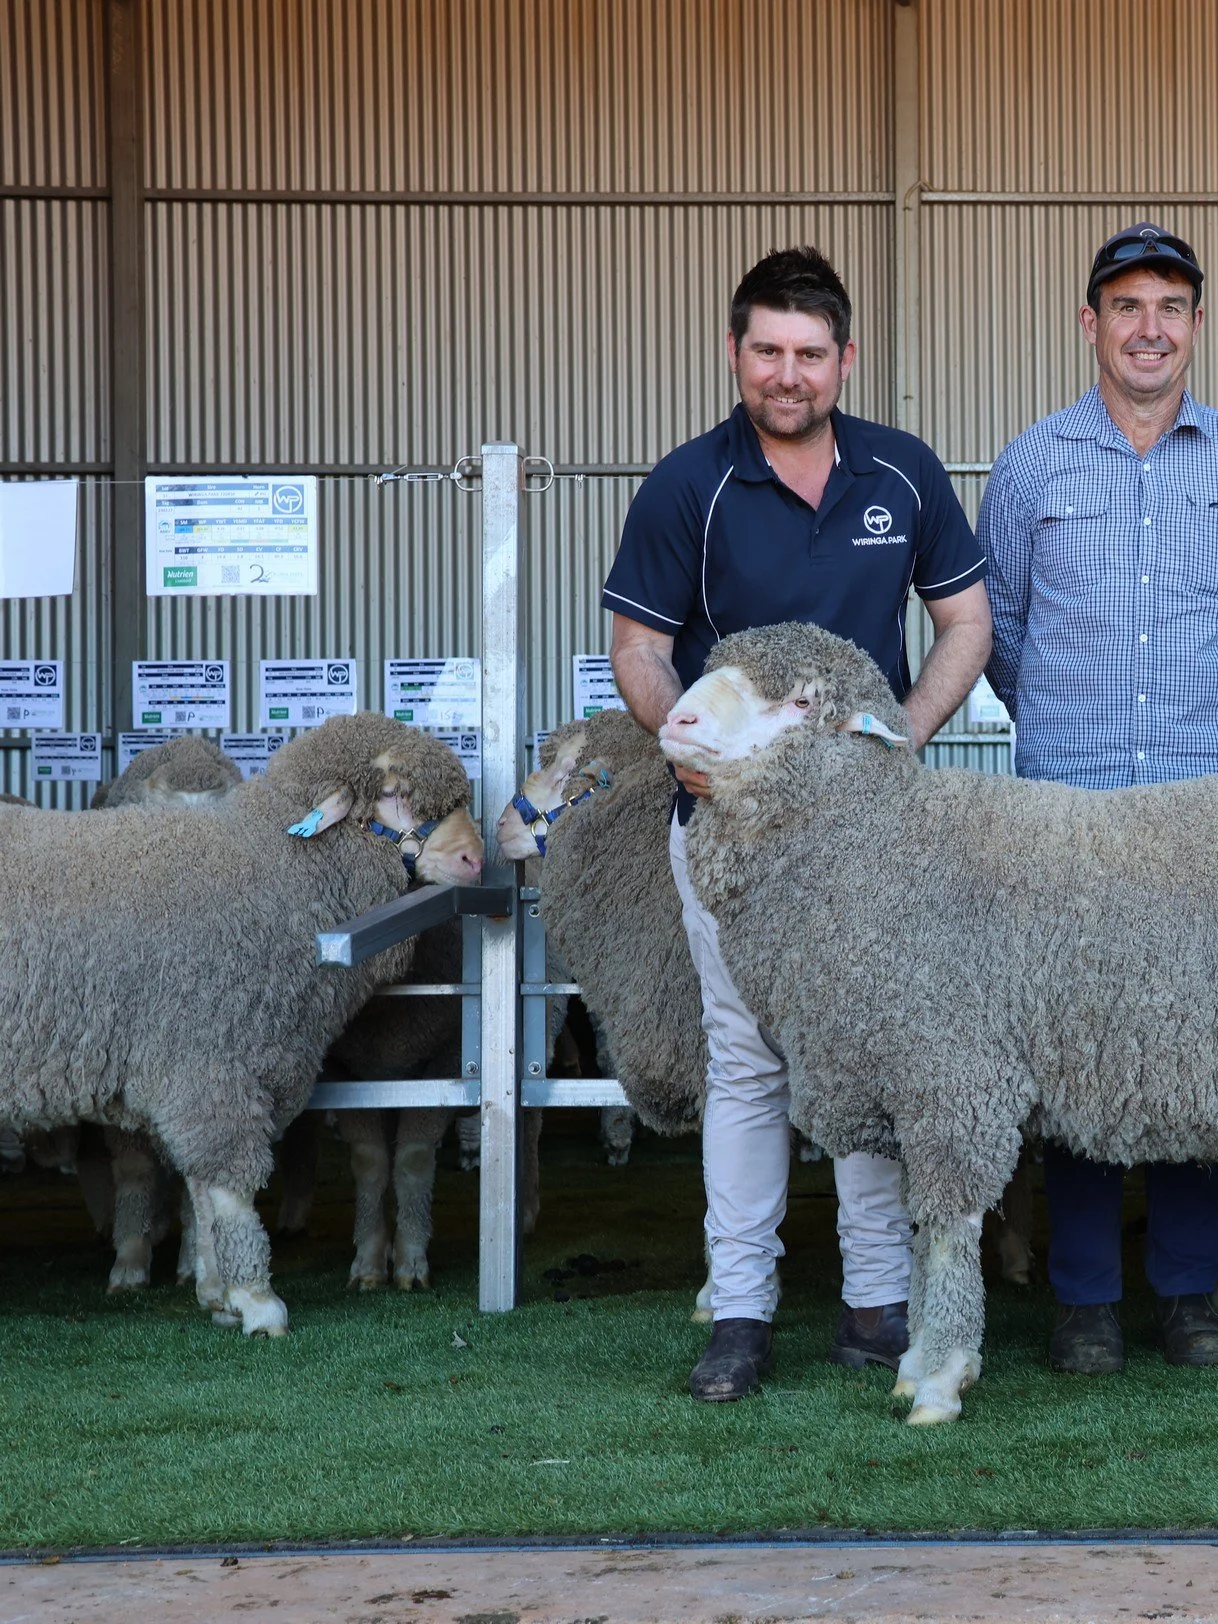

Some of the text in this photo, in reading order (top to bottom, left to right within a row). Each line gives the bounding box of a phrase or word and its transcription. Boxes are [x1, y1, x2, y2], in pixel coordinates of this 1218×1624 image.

[852, 535, 907, 546] WIRINGA PARK
[250, 564, 264, 583] 2
